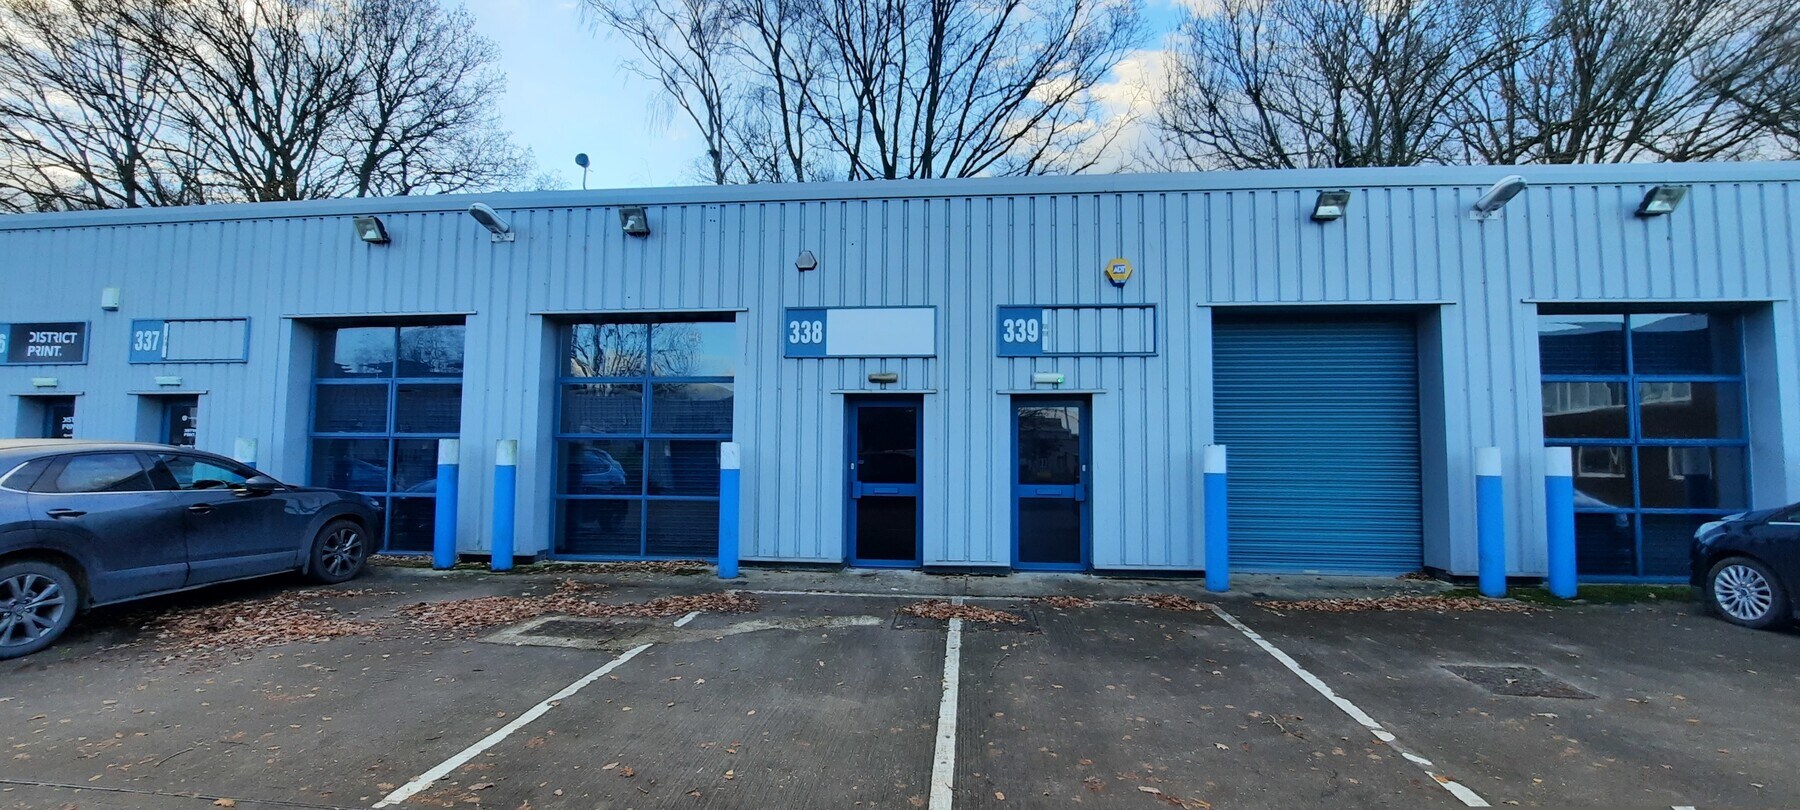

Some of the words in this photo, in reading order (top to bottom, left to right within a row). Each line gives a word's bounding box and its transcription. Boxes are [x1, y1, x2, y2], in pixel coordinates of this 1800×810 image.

[1113, 265, 1126, 273] ADT
[28, 331, 78, 344] DISTRICT
[134, 330, 160, 351] 337
[789, 320, 823, 344] 338
[1003, 318, 1039, 343] 339
